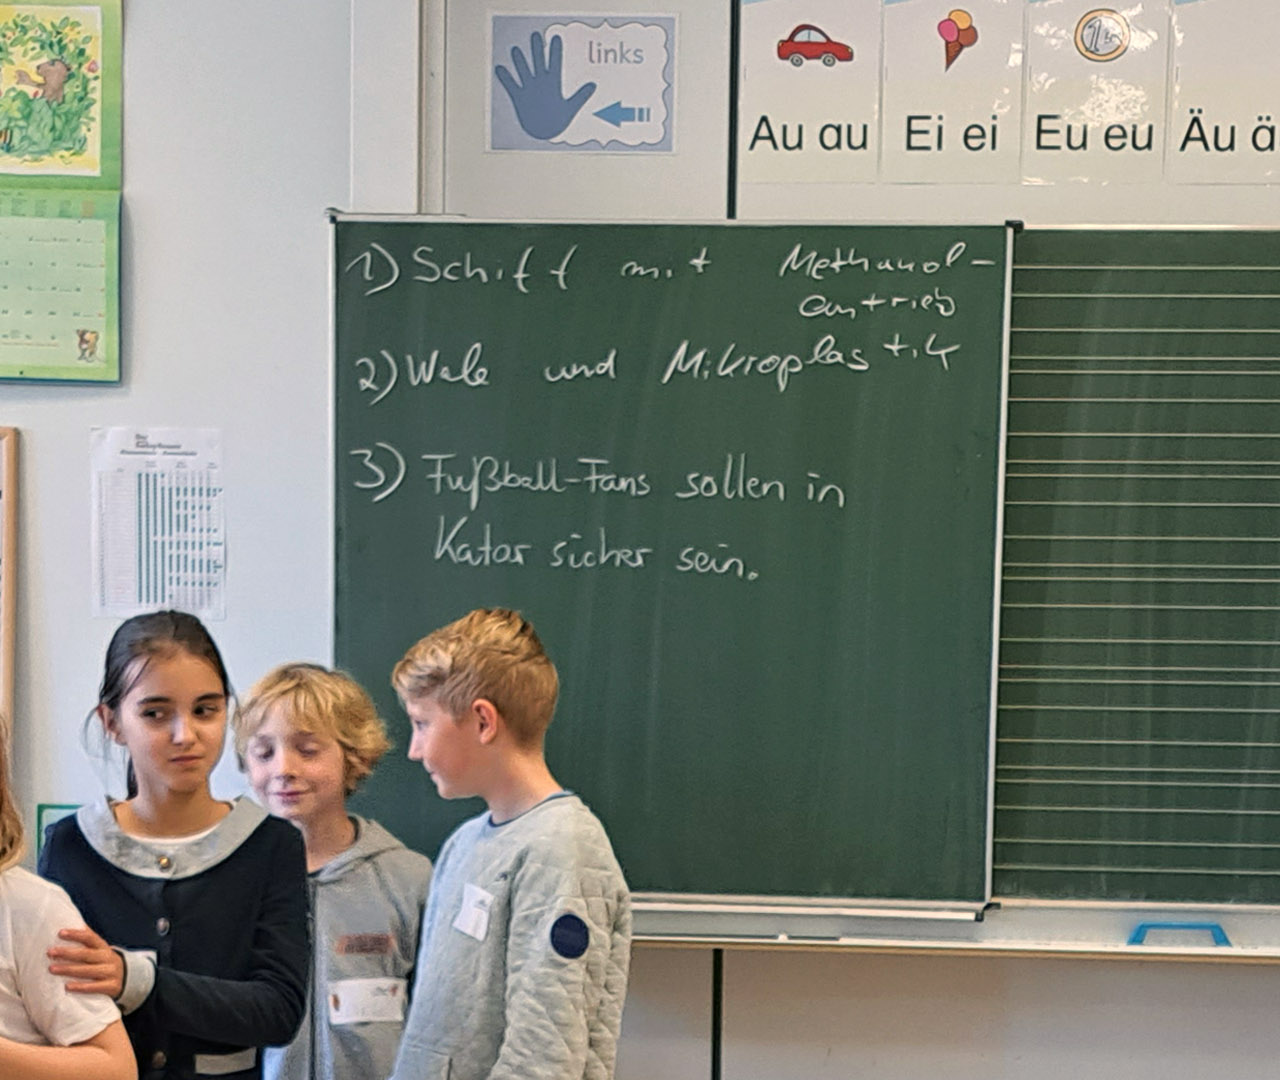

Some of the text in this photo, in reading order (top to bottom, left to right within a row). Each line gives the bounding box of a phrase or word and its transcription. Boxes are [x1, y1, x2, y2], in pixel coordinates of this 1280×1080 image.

[587, 40, 645, 65] links
[749, 115, 869, 152] Au au
[905, 114, 998, 151] Ei ei
[1035, 115, 1154, 152] Eu eu
[1179, 109, 1237, 153] Äu
[620, 246, 712, 281] mit
[545, 349, 616, 383] und
[675, 453, 785, 502] sollen
[806, 473, 844, 507] in
[434, 515, 759, 580] Katar sicher sein.
